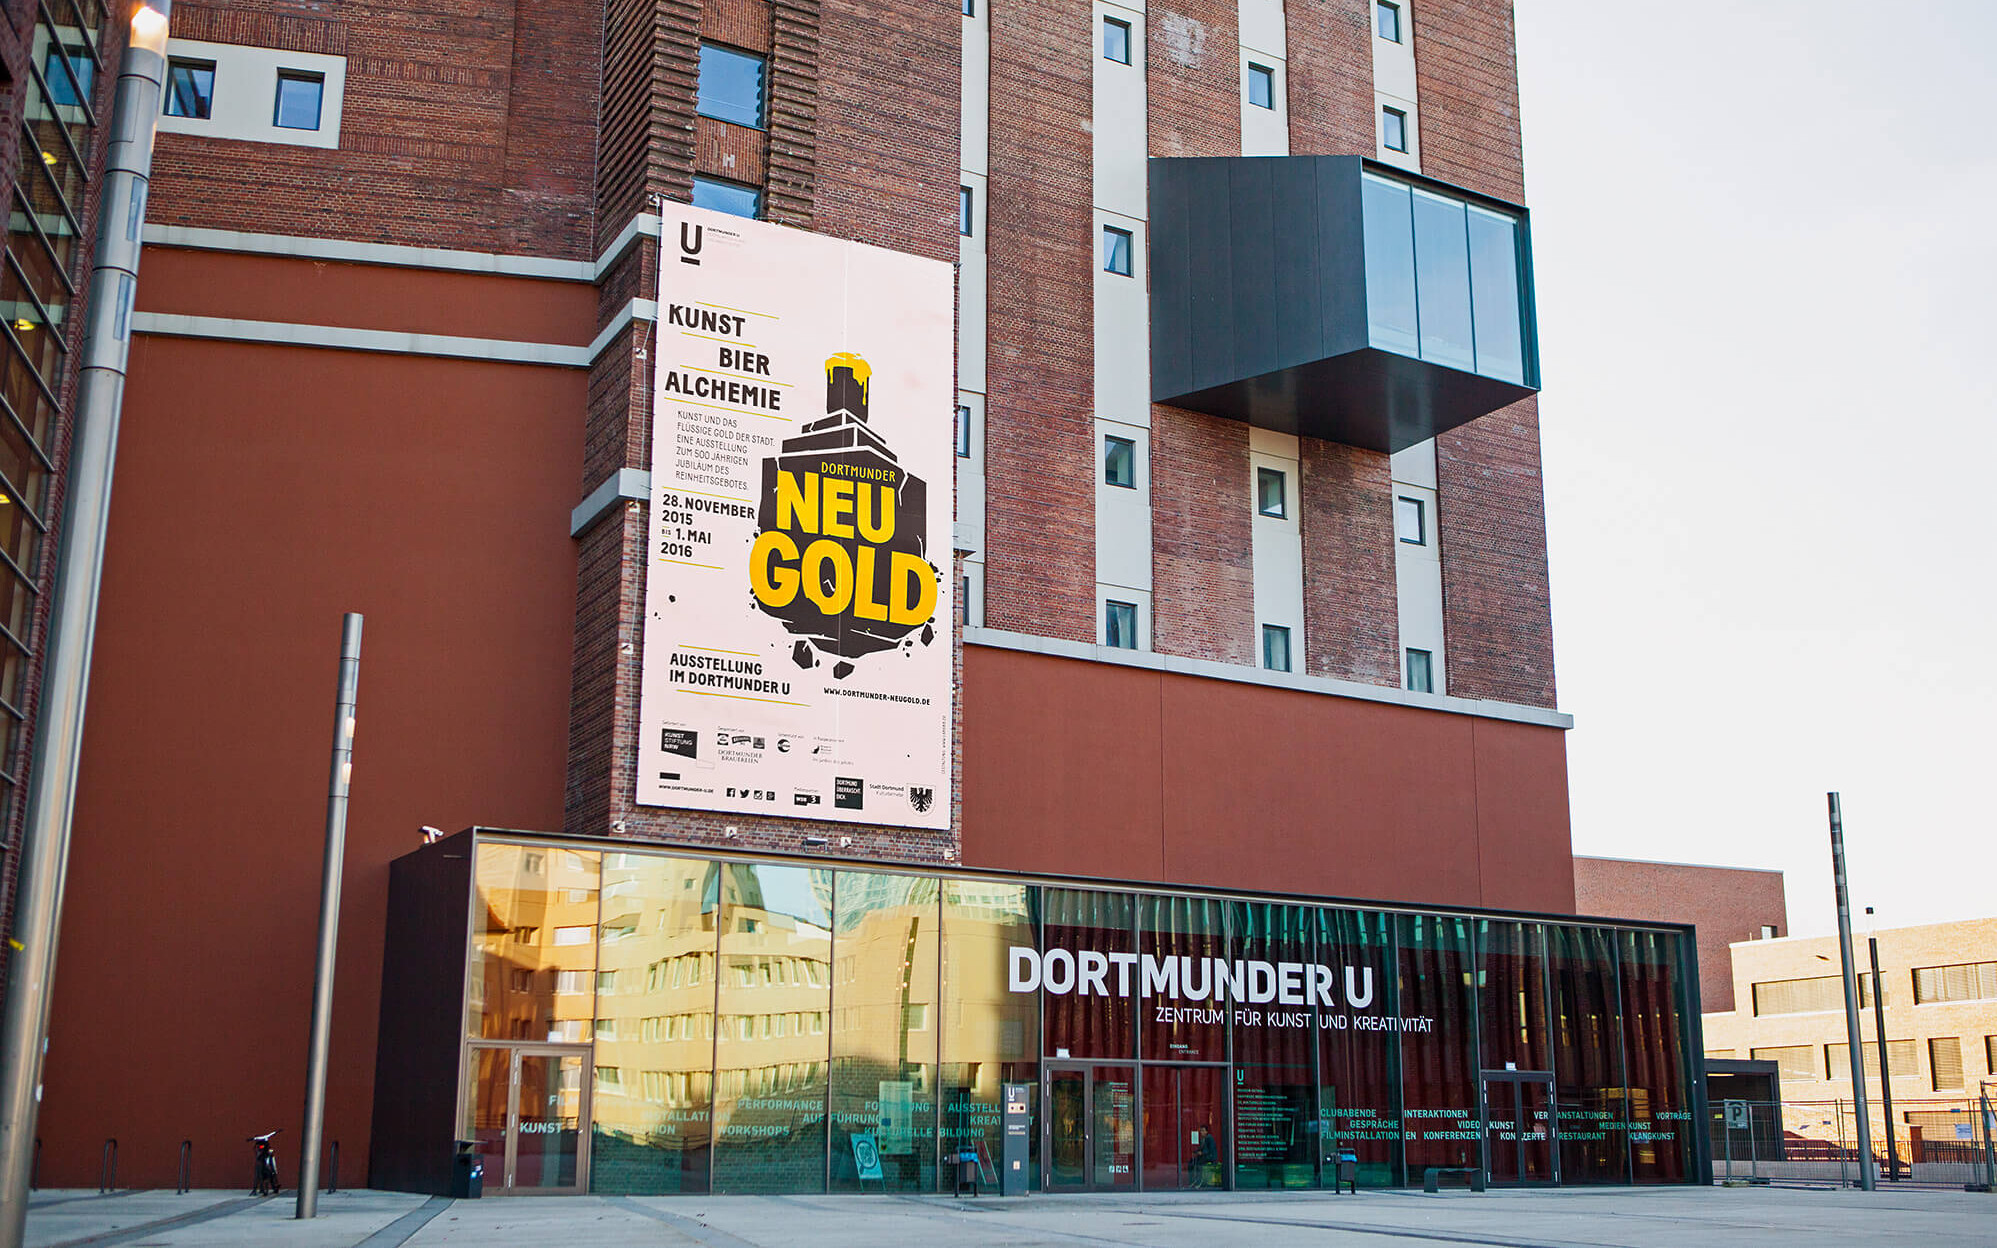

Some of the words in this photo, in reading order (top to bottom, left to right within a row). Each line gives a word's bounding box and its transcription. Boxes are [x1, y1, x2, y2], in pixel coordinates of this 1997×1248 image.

[681, 222, 703, 255] U
[669, 303, 745, 337] KUNST
[719, 347, 770, 376] BIER
[665, 371, 781, 411] ALCHEMIE
[677, 410, 703, 421] KUNST
[704, 415, 720, 425] UND
[723, 418, 738, 428] DAS
[677, 421, 712, 436] FLÜSSIGE
[714, 428, 734, 440] GOLD
[736, 432, 750, 443] DER
[676, 434, 693, 445] EINE
[696, 438, 748, 454] AUSSTELLUNG
[676, 446, 692, 457] ZUM
[694, 449, 710, 460] 500
[711, 452, 748, 466] JÄHRIGEN
[676, 459, 713, 472] JUBILÄUM
[715, 465, 730, 476] DES
[821, 462, 896, 482] DORTMUNDER
[662, 494, 682, 508] 28.
[685, 497, 756, 520] NOVEMBER
[776, 470, 896, 544] NEU
[662, 510, 693, 526] 2015
[676, 528, 685, 540] 1.
[688, 530, 711, 544] MAI
[660, 542, 692, 558] 2016
[749, 530, 938, 626] GOLD
[670, 653, 763, 676] AUSSTELLUNG
[669, 670, 684, 682] IM
[688, 672, 779, 694] DORTMUNDER
[782, 682, 790, 695] U
[824, 687, 930, 706] WWW.DORTMUNDER-NEUGOLD.DE
[1008, 946, 1334, 1007] DORTMUNDER
[1345, 966, 1374, 1008] U
[1156, 1007, 1224, 1025] ZENTRUM
[1234, 1010, 1262, 1028] FÜR
[1267, 1012, 1311, 1028] KUNST
[1319, 1013, 1347, 1030] UND
[1354, 1014, 1434, 1033] KREATIVITÄT
[1237, 1070, 1244, 1081] U
[1008, 1087, 1014, 1098] U
[738, 1100, 823, 1111] PERFORMANCE
[1320, 1108, 1376, 1118] CLUBABENDE
[1733, 1106, 1742, 1121] P
[1404, 1110, 1468, 1119] INTERAKTIONEN
[1656, 1110, 1692, 1120] VORTRÄGE
[520, 1122, 562, 1134] KUNST
[718, 1126, 790, 1136] WORKSHOPS
[940, 1127, 984, 1137] BILDUNG
[1350, 1118, 1399, 1129] GESPRÄCHE
[1424, 1131, 1481, 1140] KONFERENZEN
[1558, 1132, 1606, 1141] RESTAURANT
[1629, 1132, 1675, 1140] KLANGKUNST
